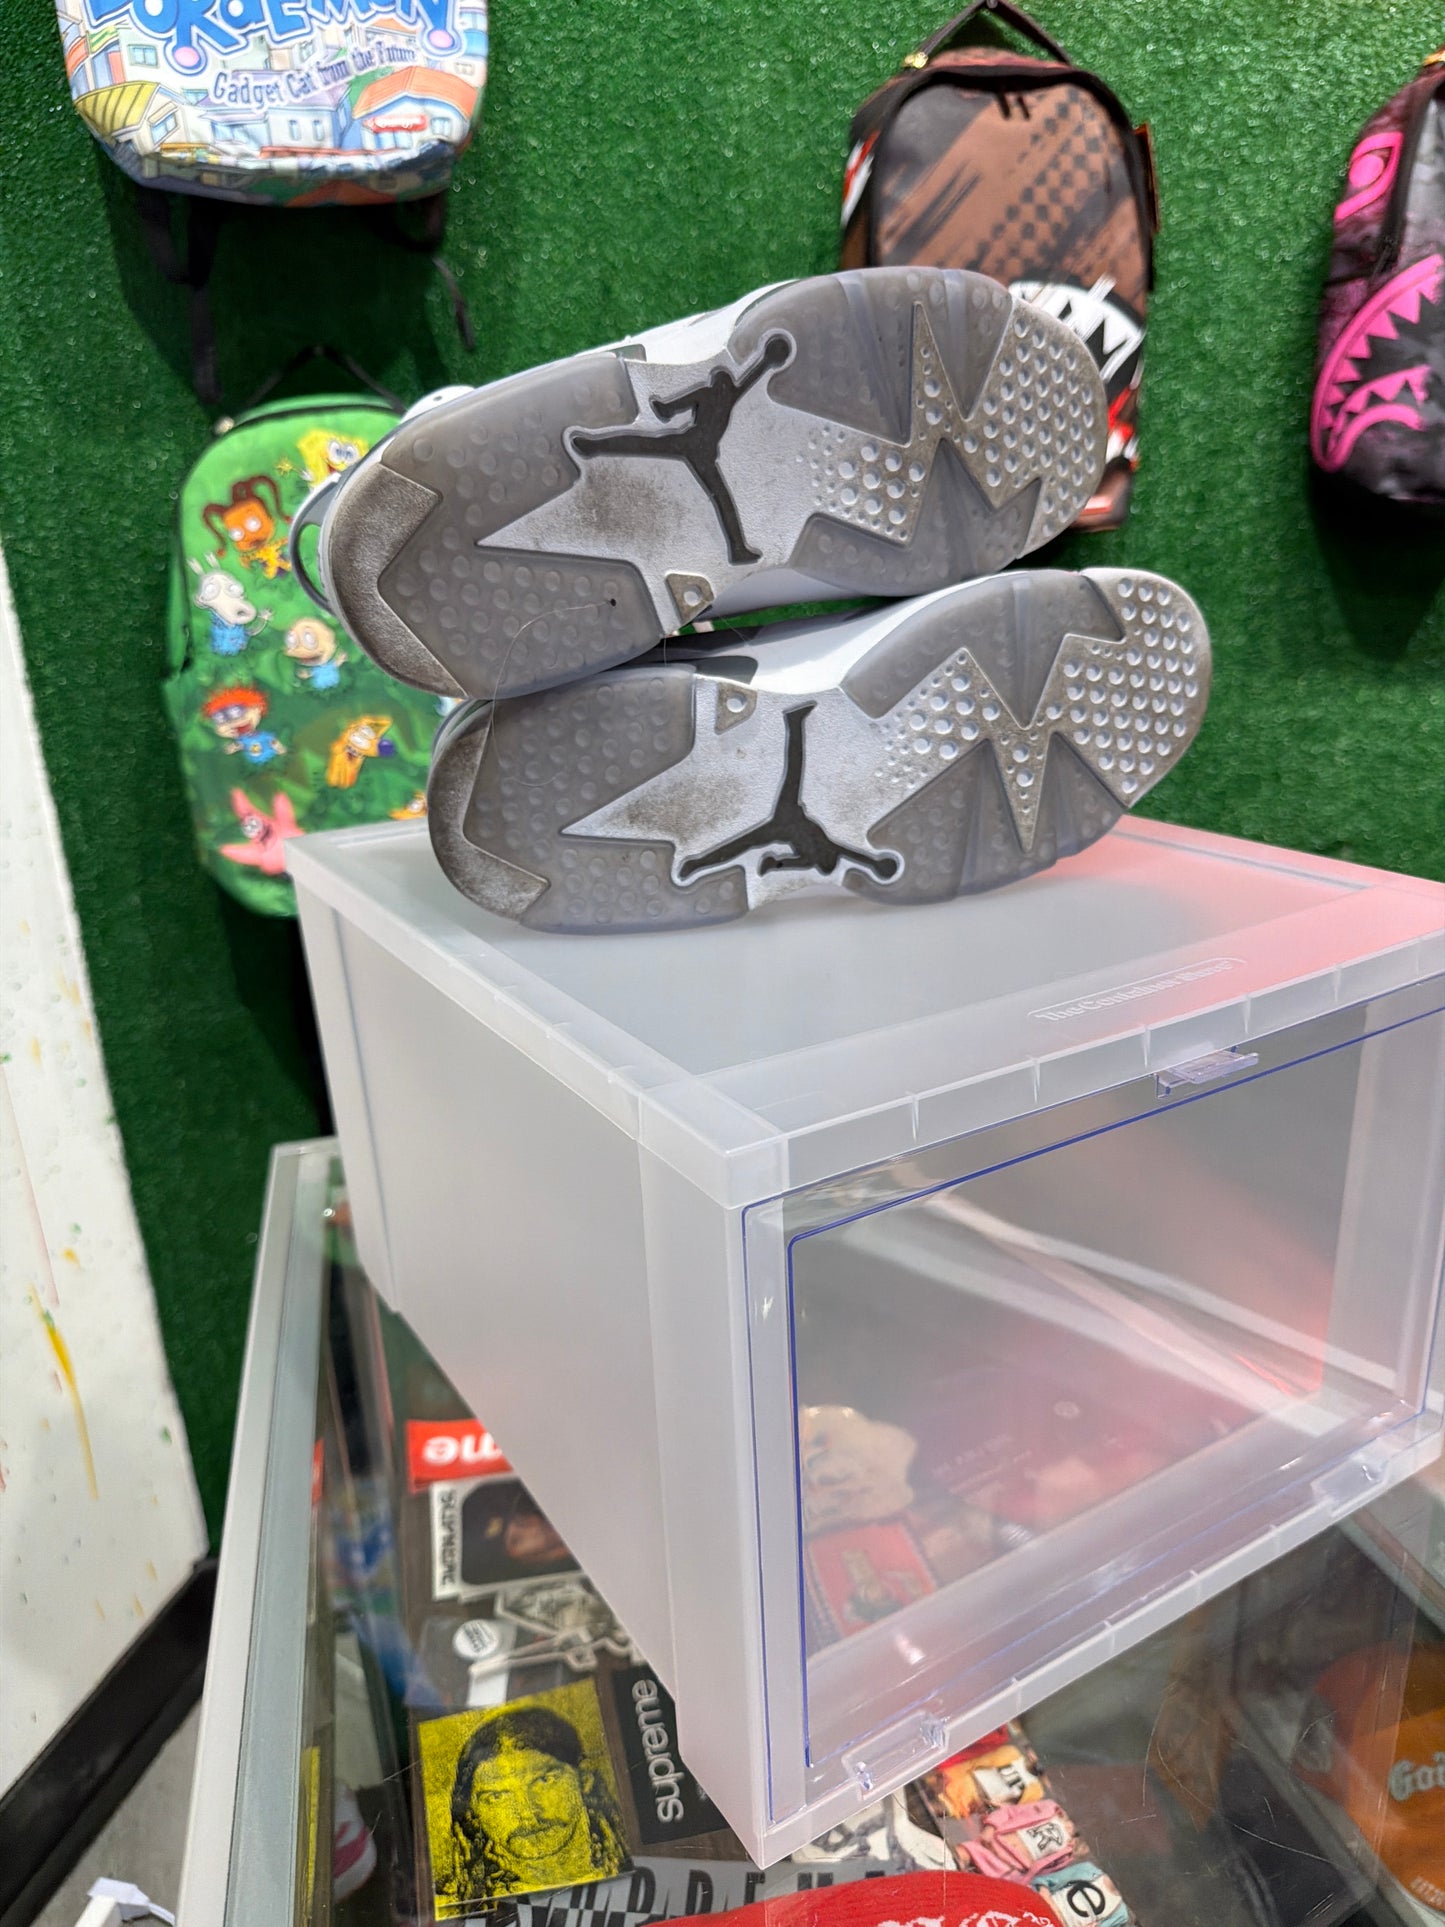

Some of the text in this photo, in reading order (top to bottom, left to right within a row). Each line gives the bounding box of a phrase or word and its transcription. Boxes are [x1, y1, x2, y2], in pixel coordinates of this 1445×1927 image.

[213, 72, 281, 106] Gadget
[286, 72, 313, 97] Cat
[316, 61, 348, 86] from
[352, 49, 374, 71] the
[631, 1679, 685, 1823] supreme
